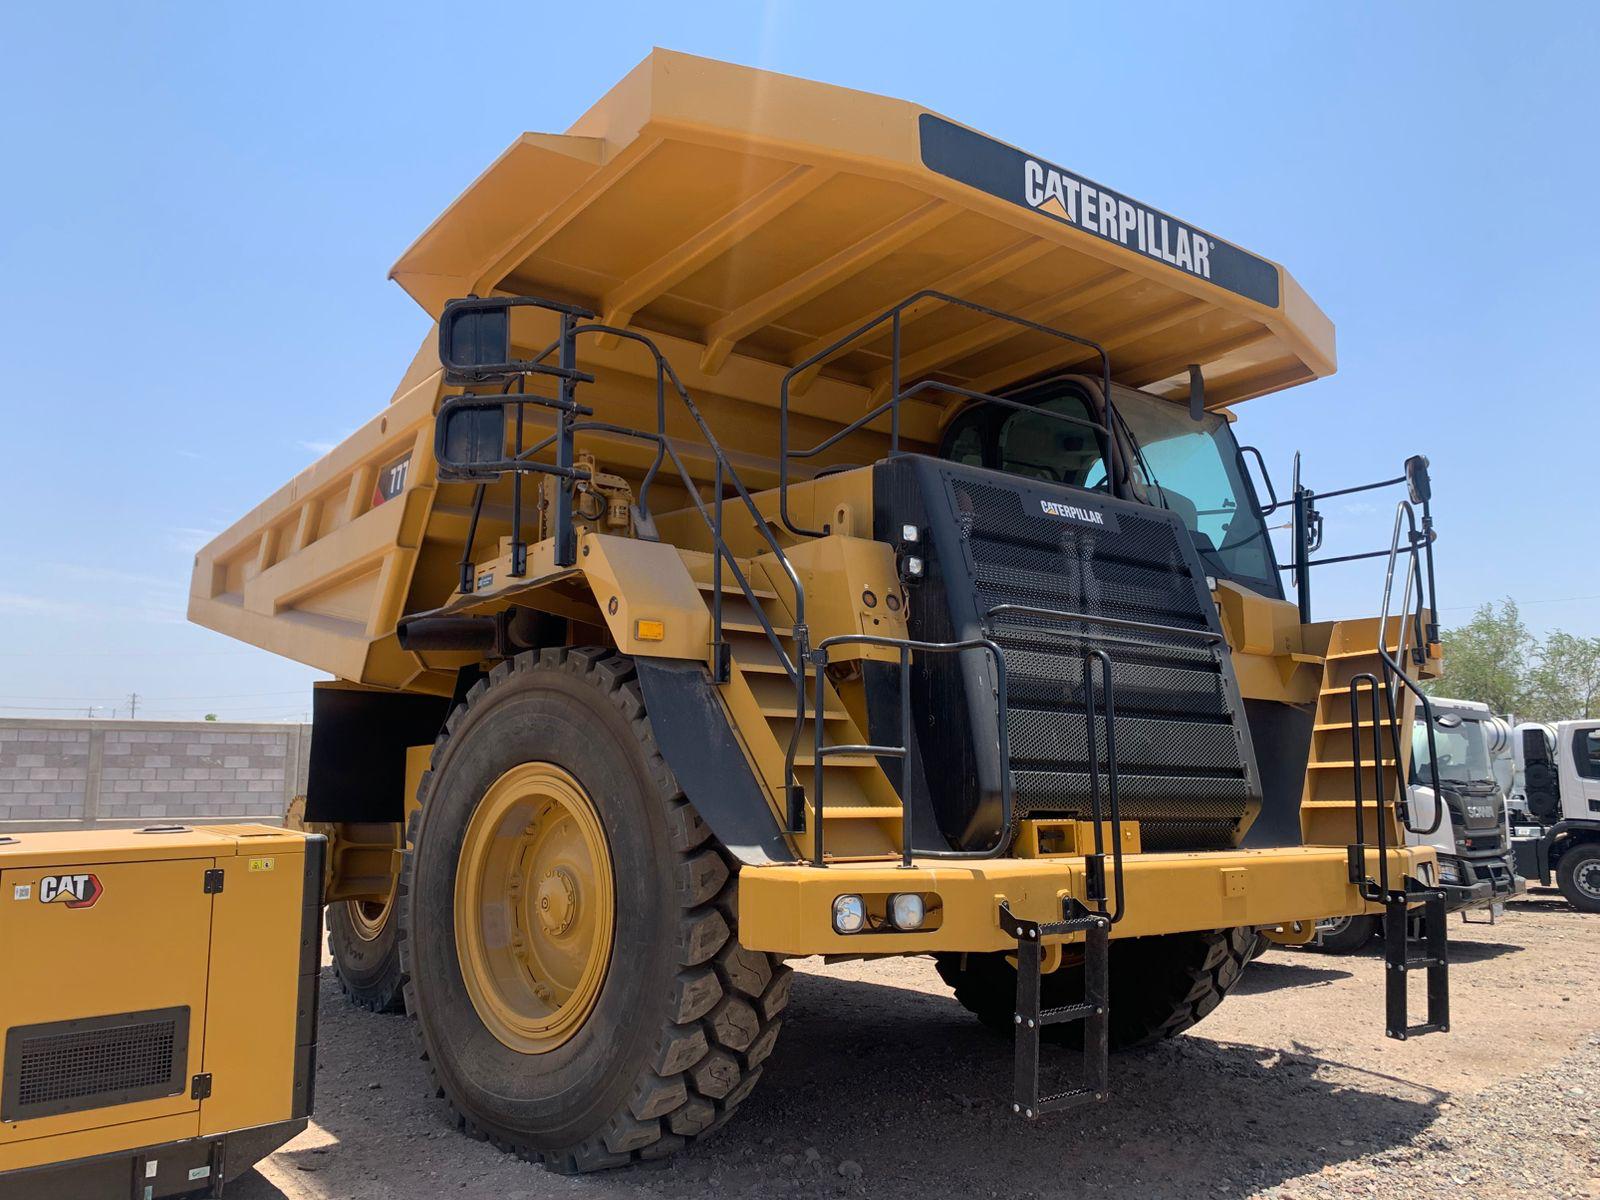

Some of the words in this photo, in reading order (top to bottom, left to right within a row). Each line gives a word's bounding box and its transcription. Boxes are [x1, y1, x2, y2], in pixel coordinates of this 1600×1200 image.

[1025, 160, 1211, 279] CATERPILLAR
[1040, 500, 1103, 524] CATERPILLAR
[41, 875, 89, 903] CAT
